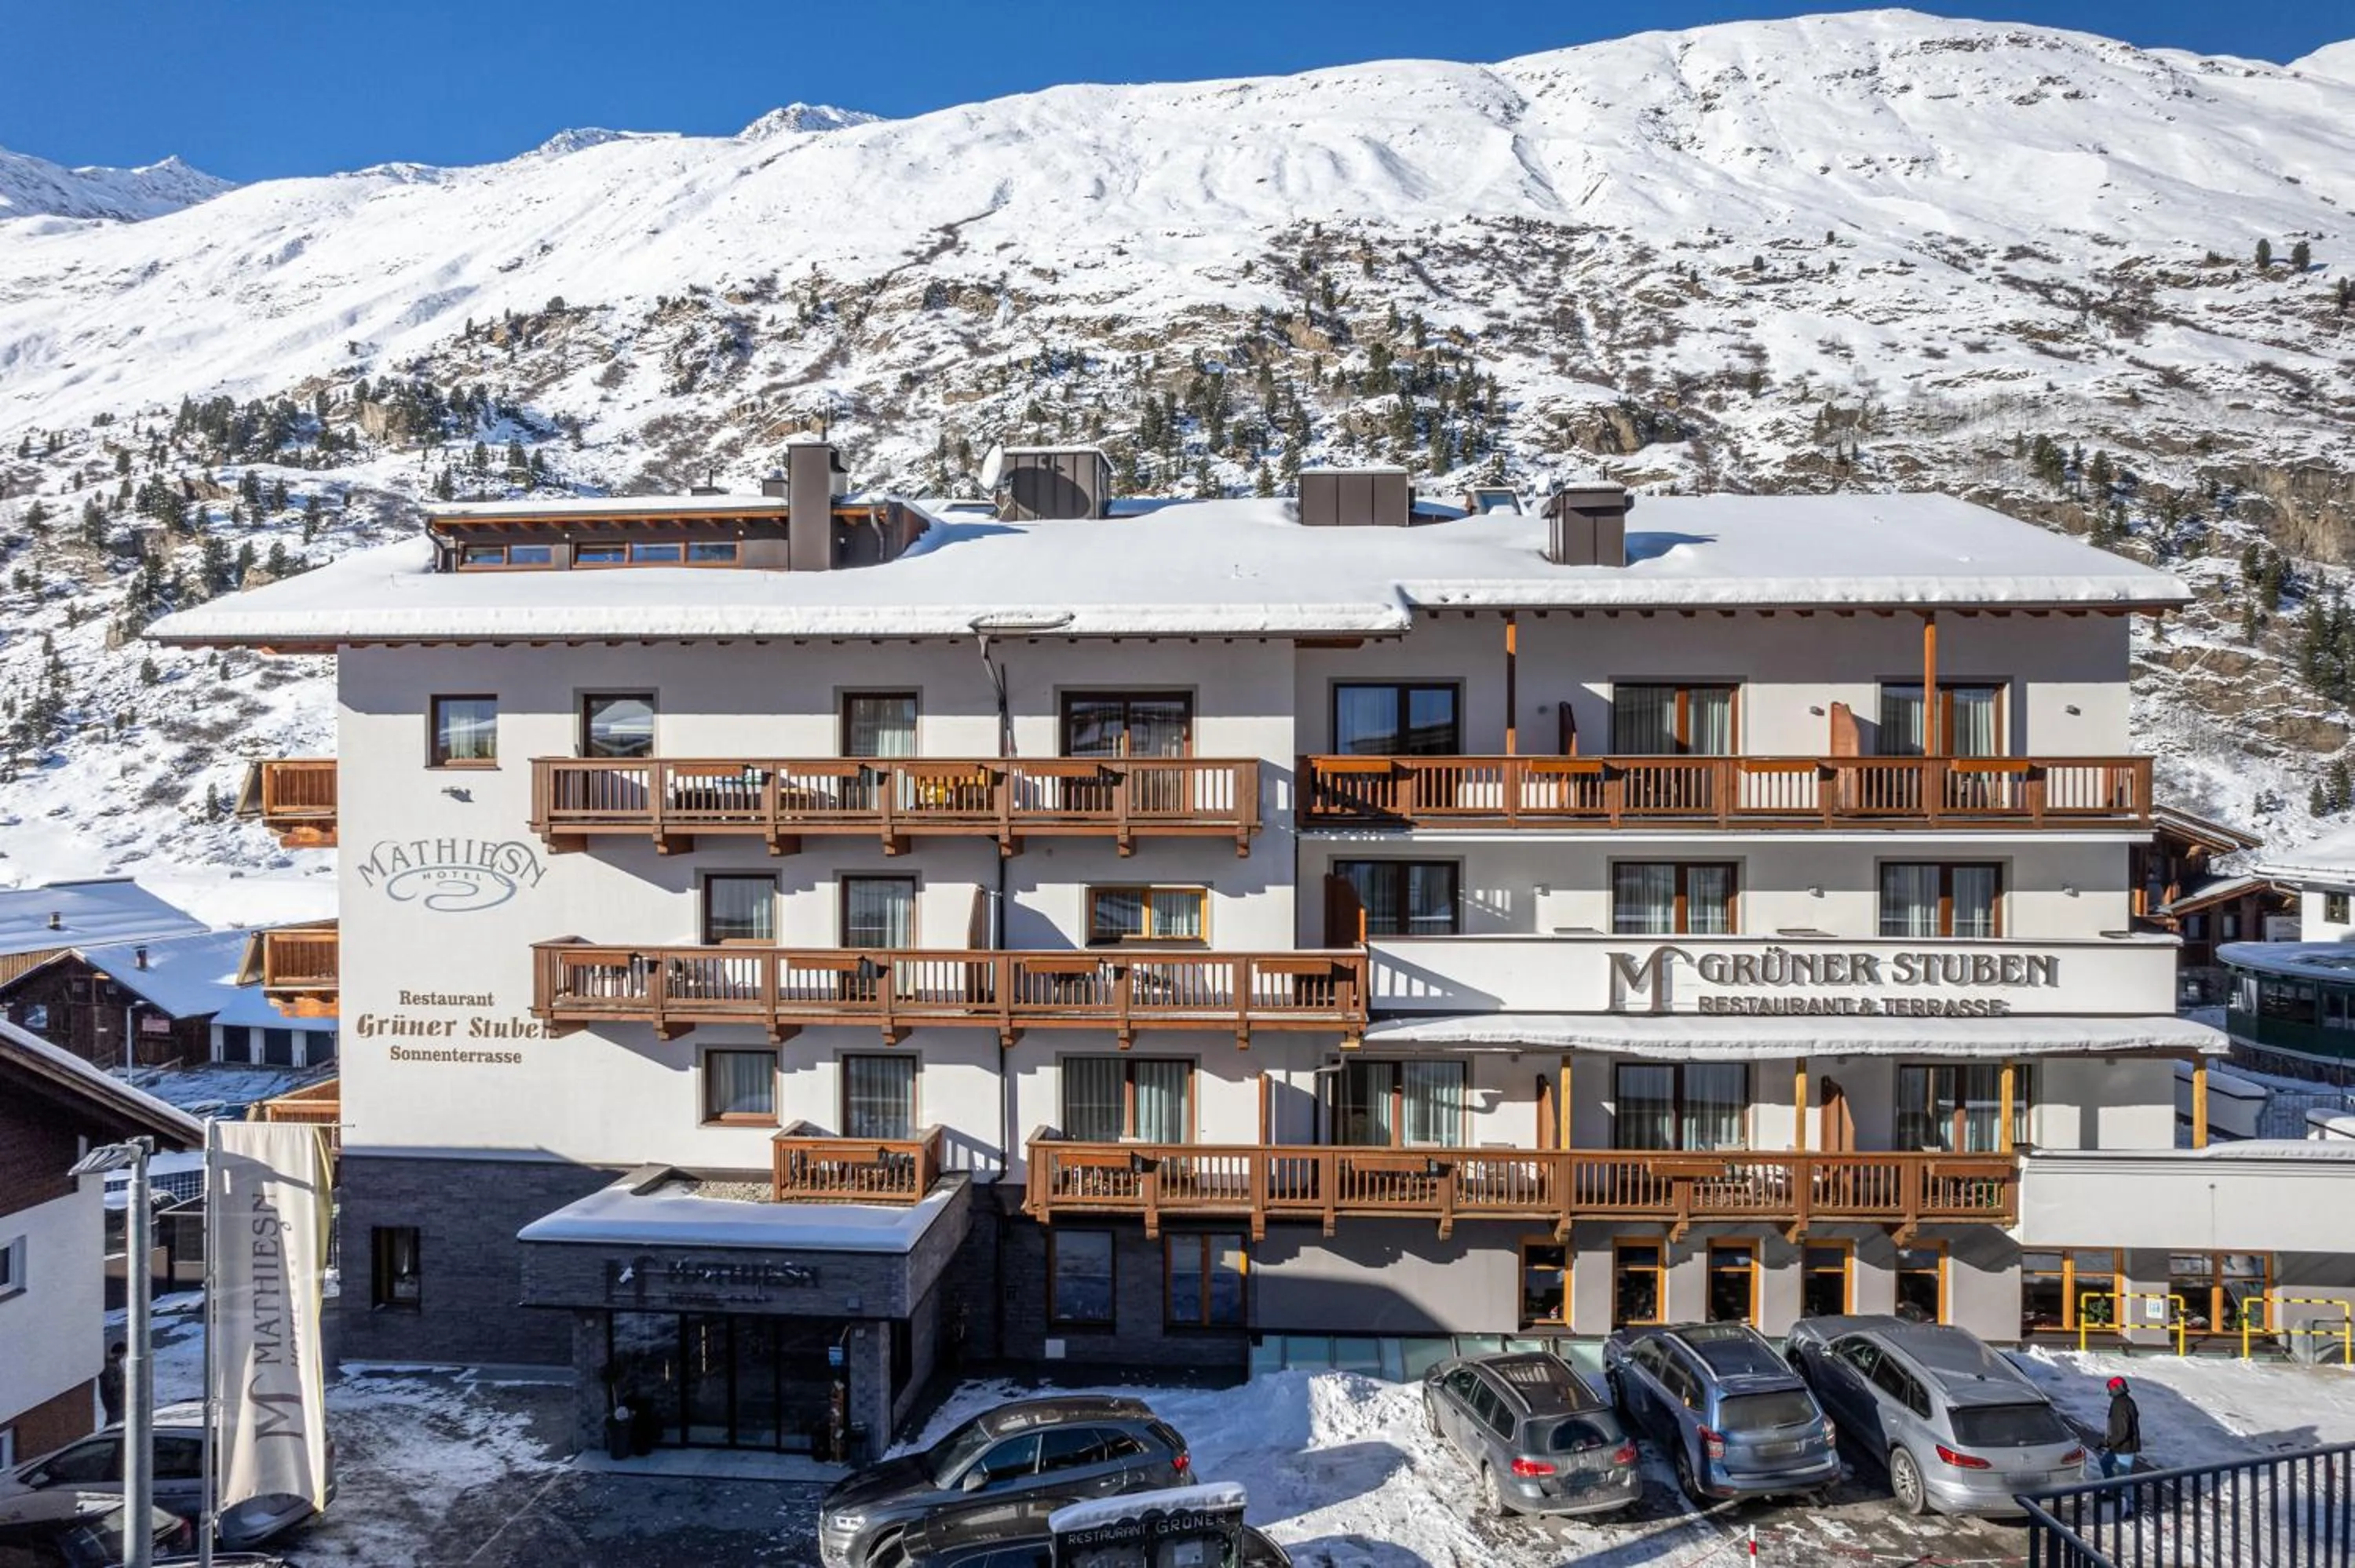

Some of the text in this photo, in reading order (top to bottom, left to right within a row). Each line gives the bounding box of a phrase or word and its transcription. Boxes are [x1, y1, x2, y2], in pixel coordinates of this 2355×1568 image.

[422, 870, 483, 881] HOTEL
[1697, 946, 2060, 987] GRÜNER STUBEN
[399, 990, 495, 1007] Restaurant
[1698, 996, 2010, 1017] RESTAURANT & TERRASSE
[357, 1014, 458, 1039] Grüner
[390, 1046, 523, 1064] Sonnenterrasse
[252, 1193, 281, 1366] MATHIESN
[1068, 1523, 1147, 1546] RESTAURANT
